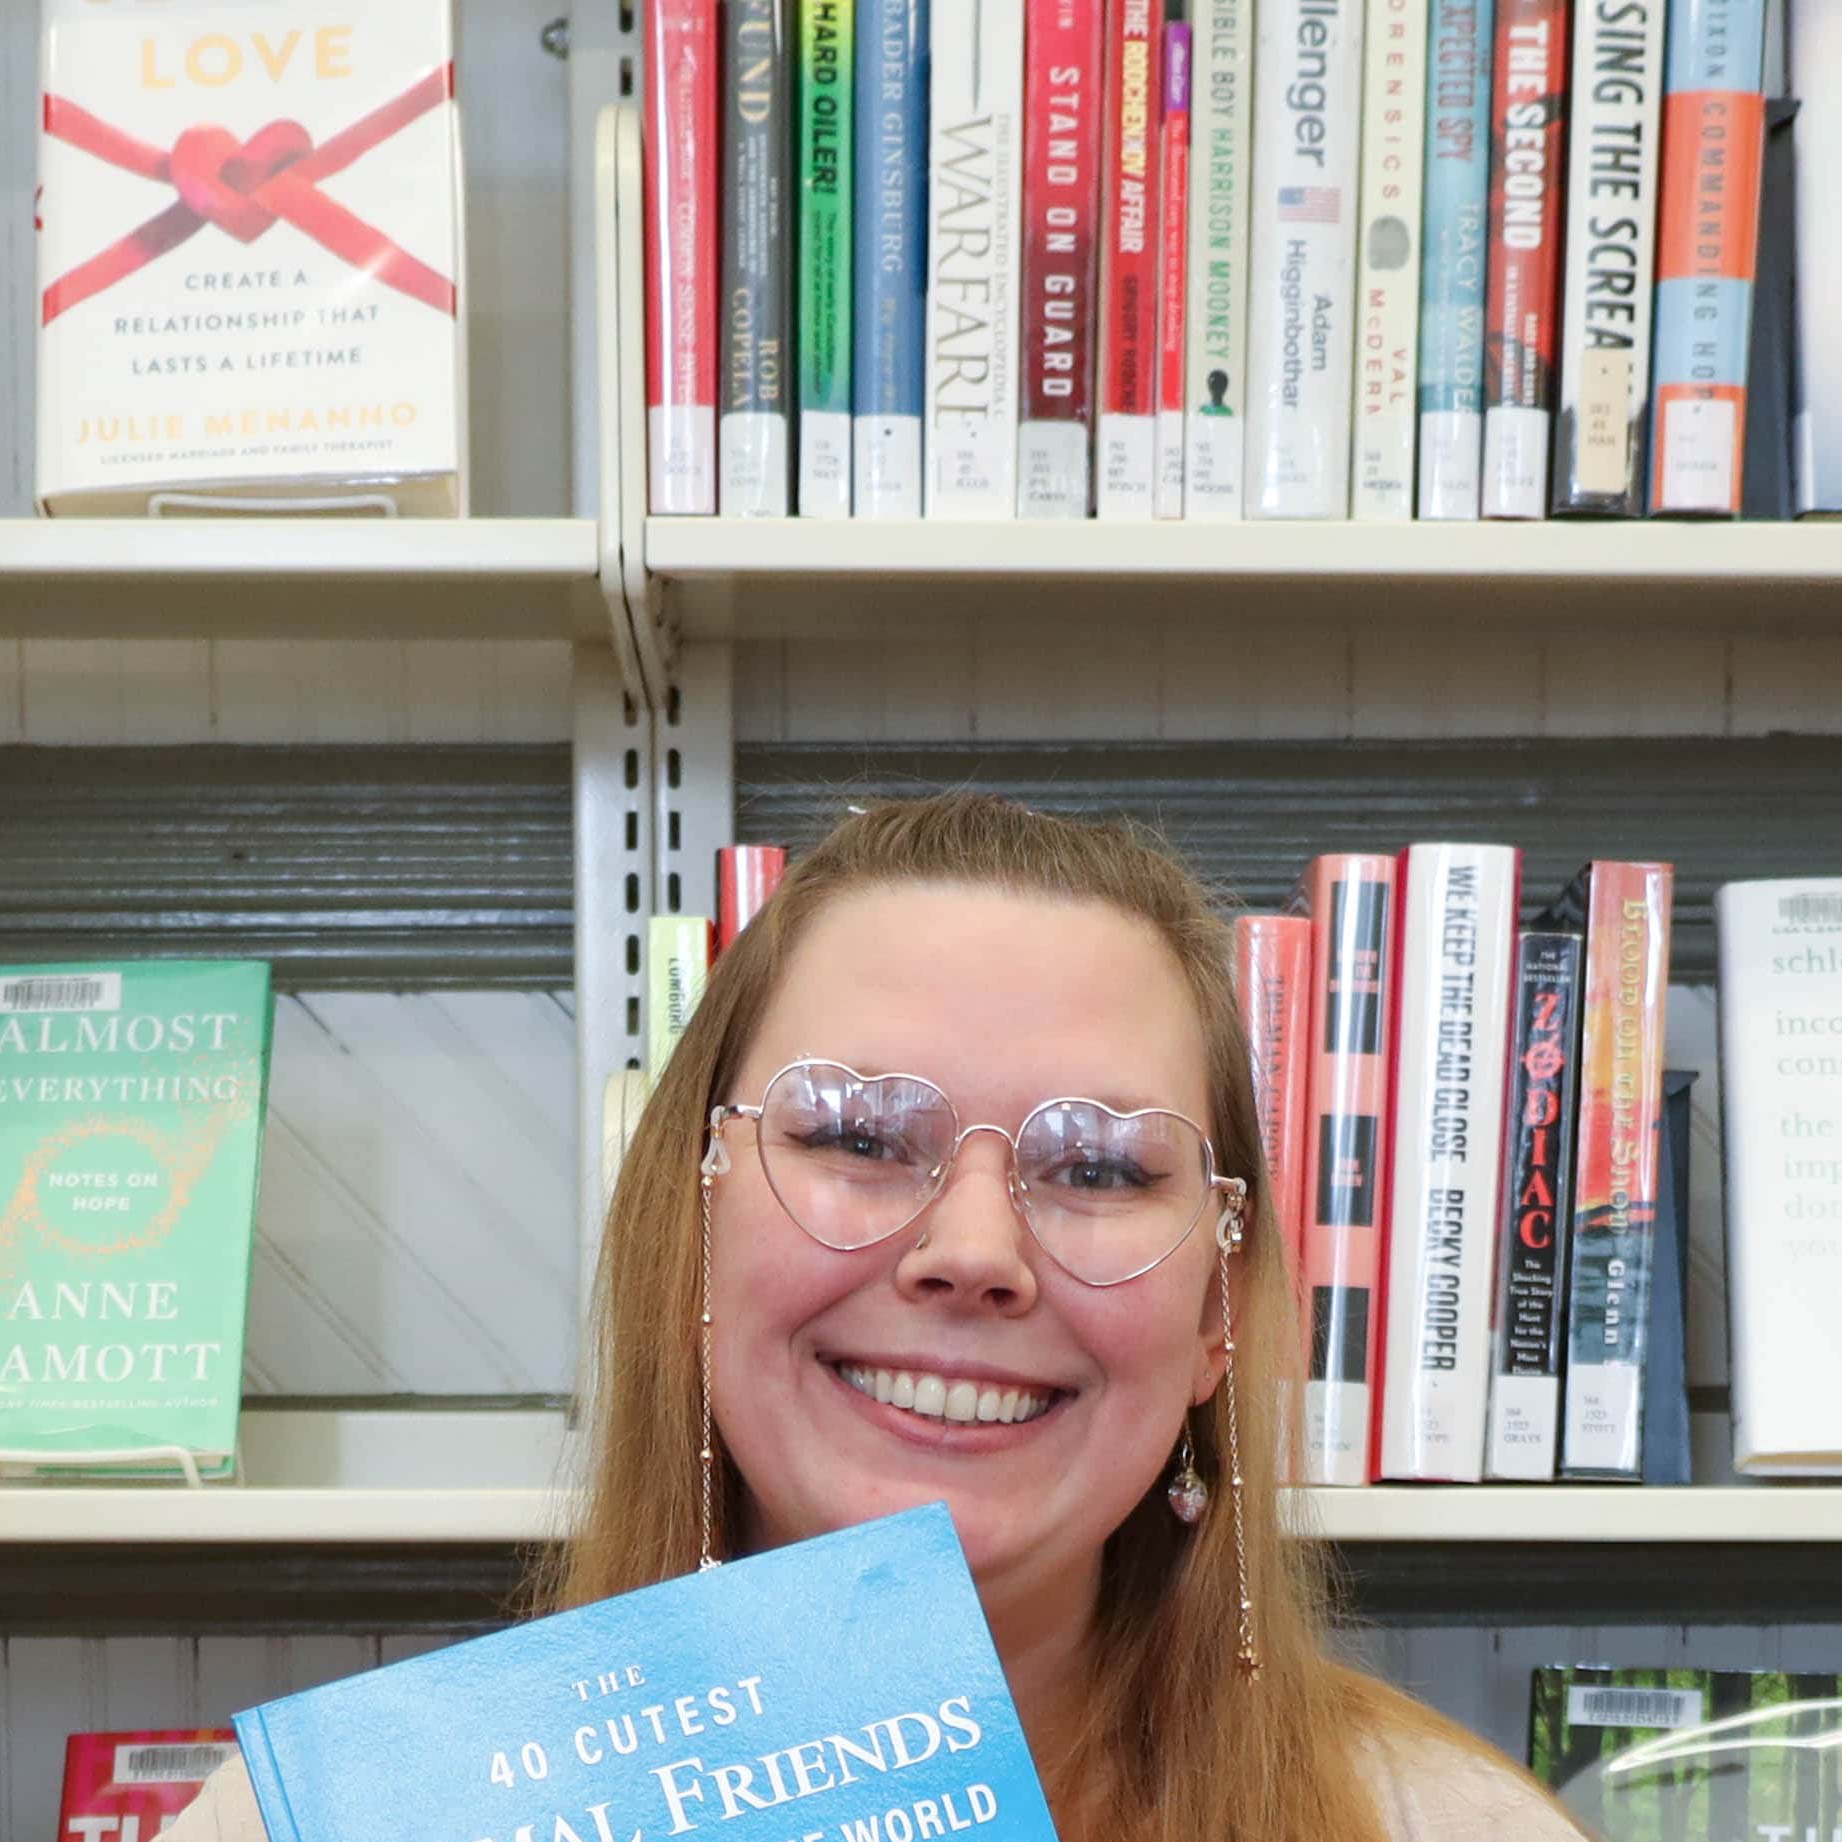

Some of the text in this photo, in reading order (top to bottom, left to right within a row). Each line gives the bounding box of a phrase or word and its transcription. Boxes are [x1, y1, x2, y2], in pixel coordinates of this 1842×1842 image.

[140, 24, 352, 89] LOVE
[1043, 67, 1079, 395] STAND ON GUARD
[185, 270, 307, 291] CREATE A
[115, 305, 380, 334] RELATIONSHIP THAT
[132, 348, 362, 374] LASTS A LIFETIME
[75, 402, 417, 443] JULIE MENANNO
[1780, 1116, 1833, 1138] the
[49, 1173, 157, 1186] NOTES ON
[72, 1196, 130, 1211] HOPE
[7, 1283, 180, 1320] ANNE
[571, 1663, 647, 1703] THE
[489, 1676, 766, 1790] 40 CUTEST
[649, 1695, 983, 1836] FRIENDS
